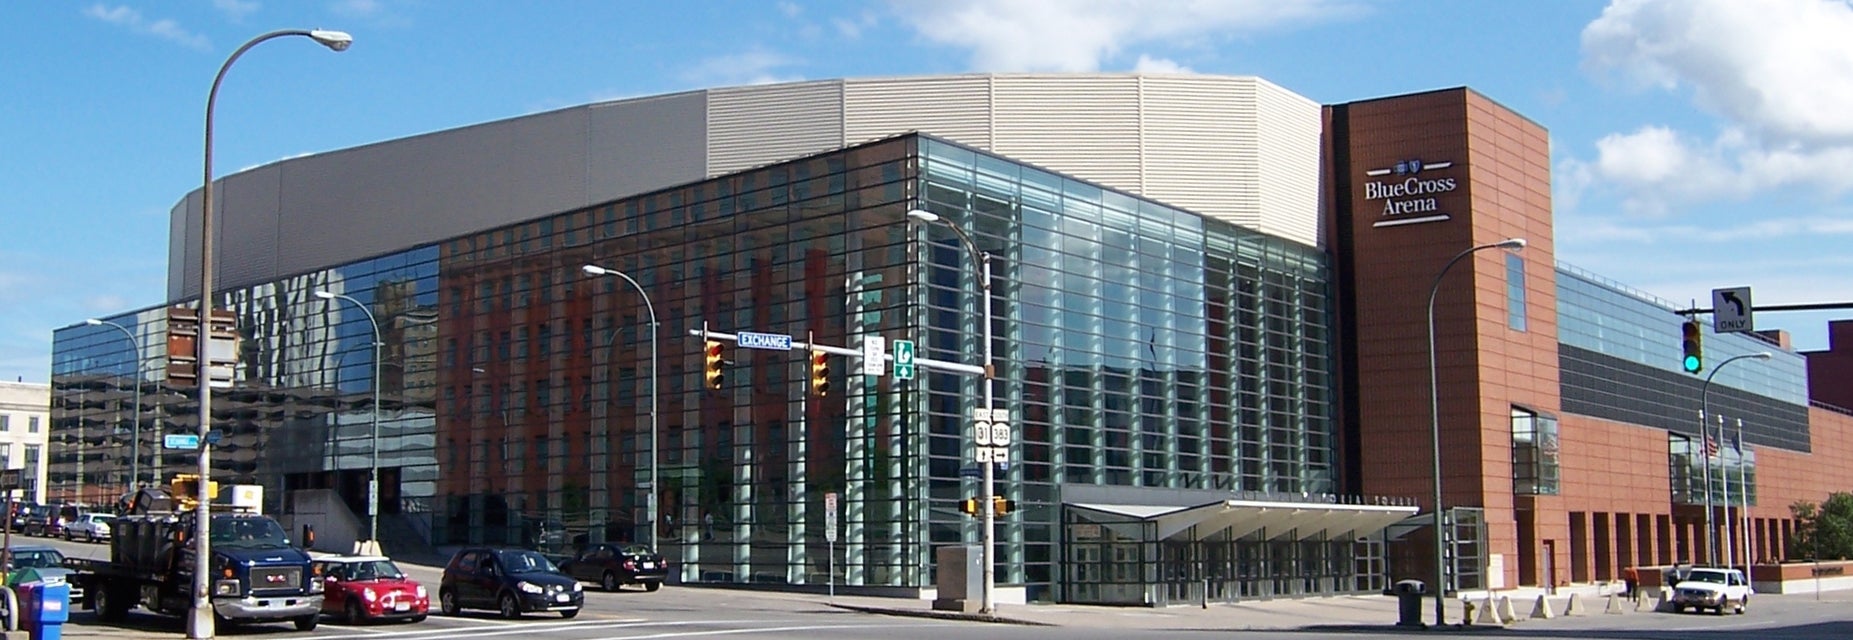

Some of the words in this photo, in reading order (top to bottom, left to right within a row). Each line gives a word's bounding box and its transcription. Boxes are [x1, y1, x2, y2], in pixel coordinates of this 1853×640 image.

[1365, 177, 1456, 200] BlueCross
[1382, 198, 1436, 216] Arena
[1720, 319, 1746, 329] ONLY
[741, 334, 788, 348] EXCHANGE
[977, 427, 988, 440] 31
[994, 428, 1008, 440] 383
